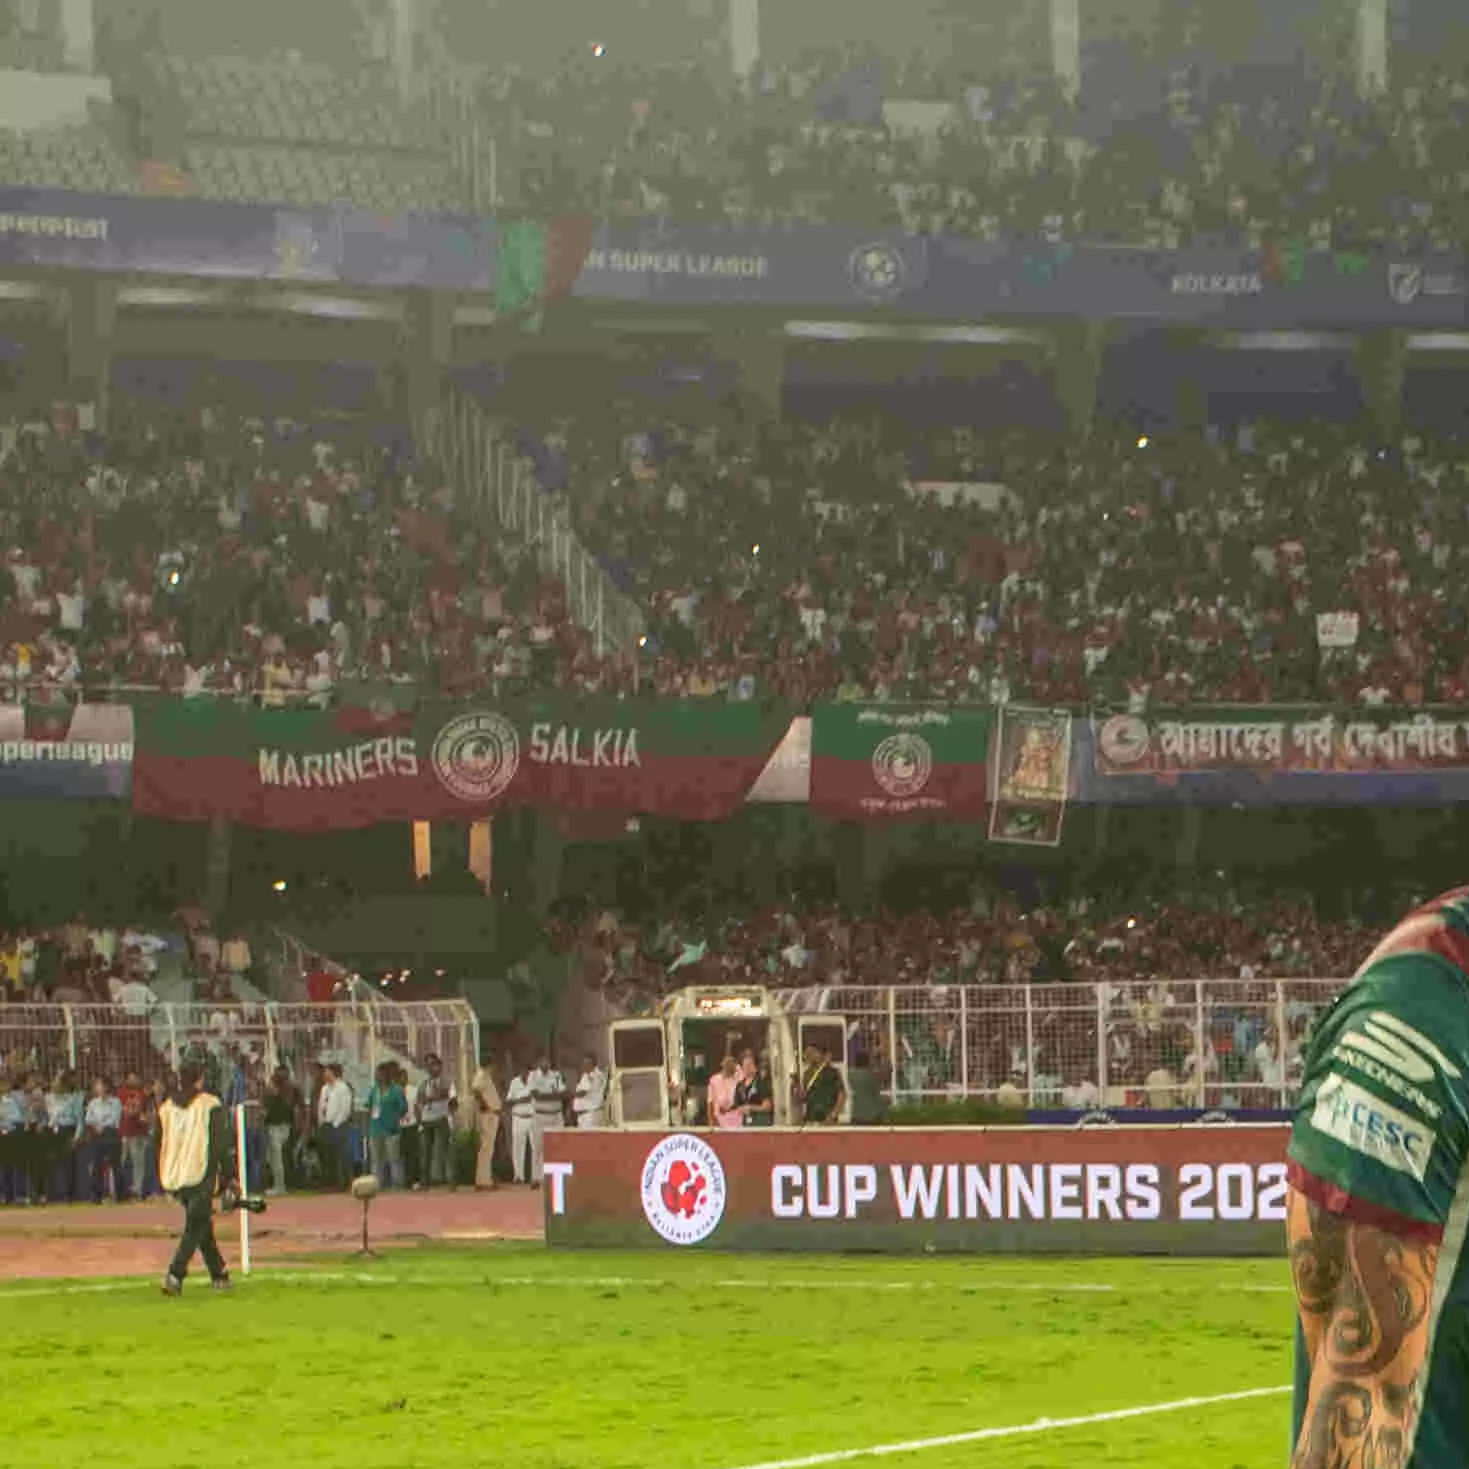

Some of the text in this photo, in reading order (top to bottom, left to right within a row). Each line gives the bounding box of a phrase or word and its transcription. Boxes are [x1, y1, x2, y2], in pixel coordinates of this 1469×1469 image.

[0, 742, 133, 768] perleague
[258, 735, 419, 788] MARINERS
[529, 722, 642, 769] SALKIA
[1352, 1101, 1423, 1153] CESC
[770, 1162, 1287, 1219] CUP WINNERS 202
